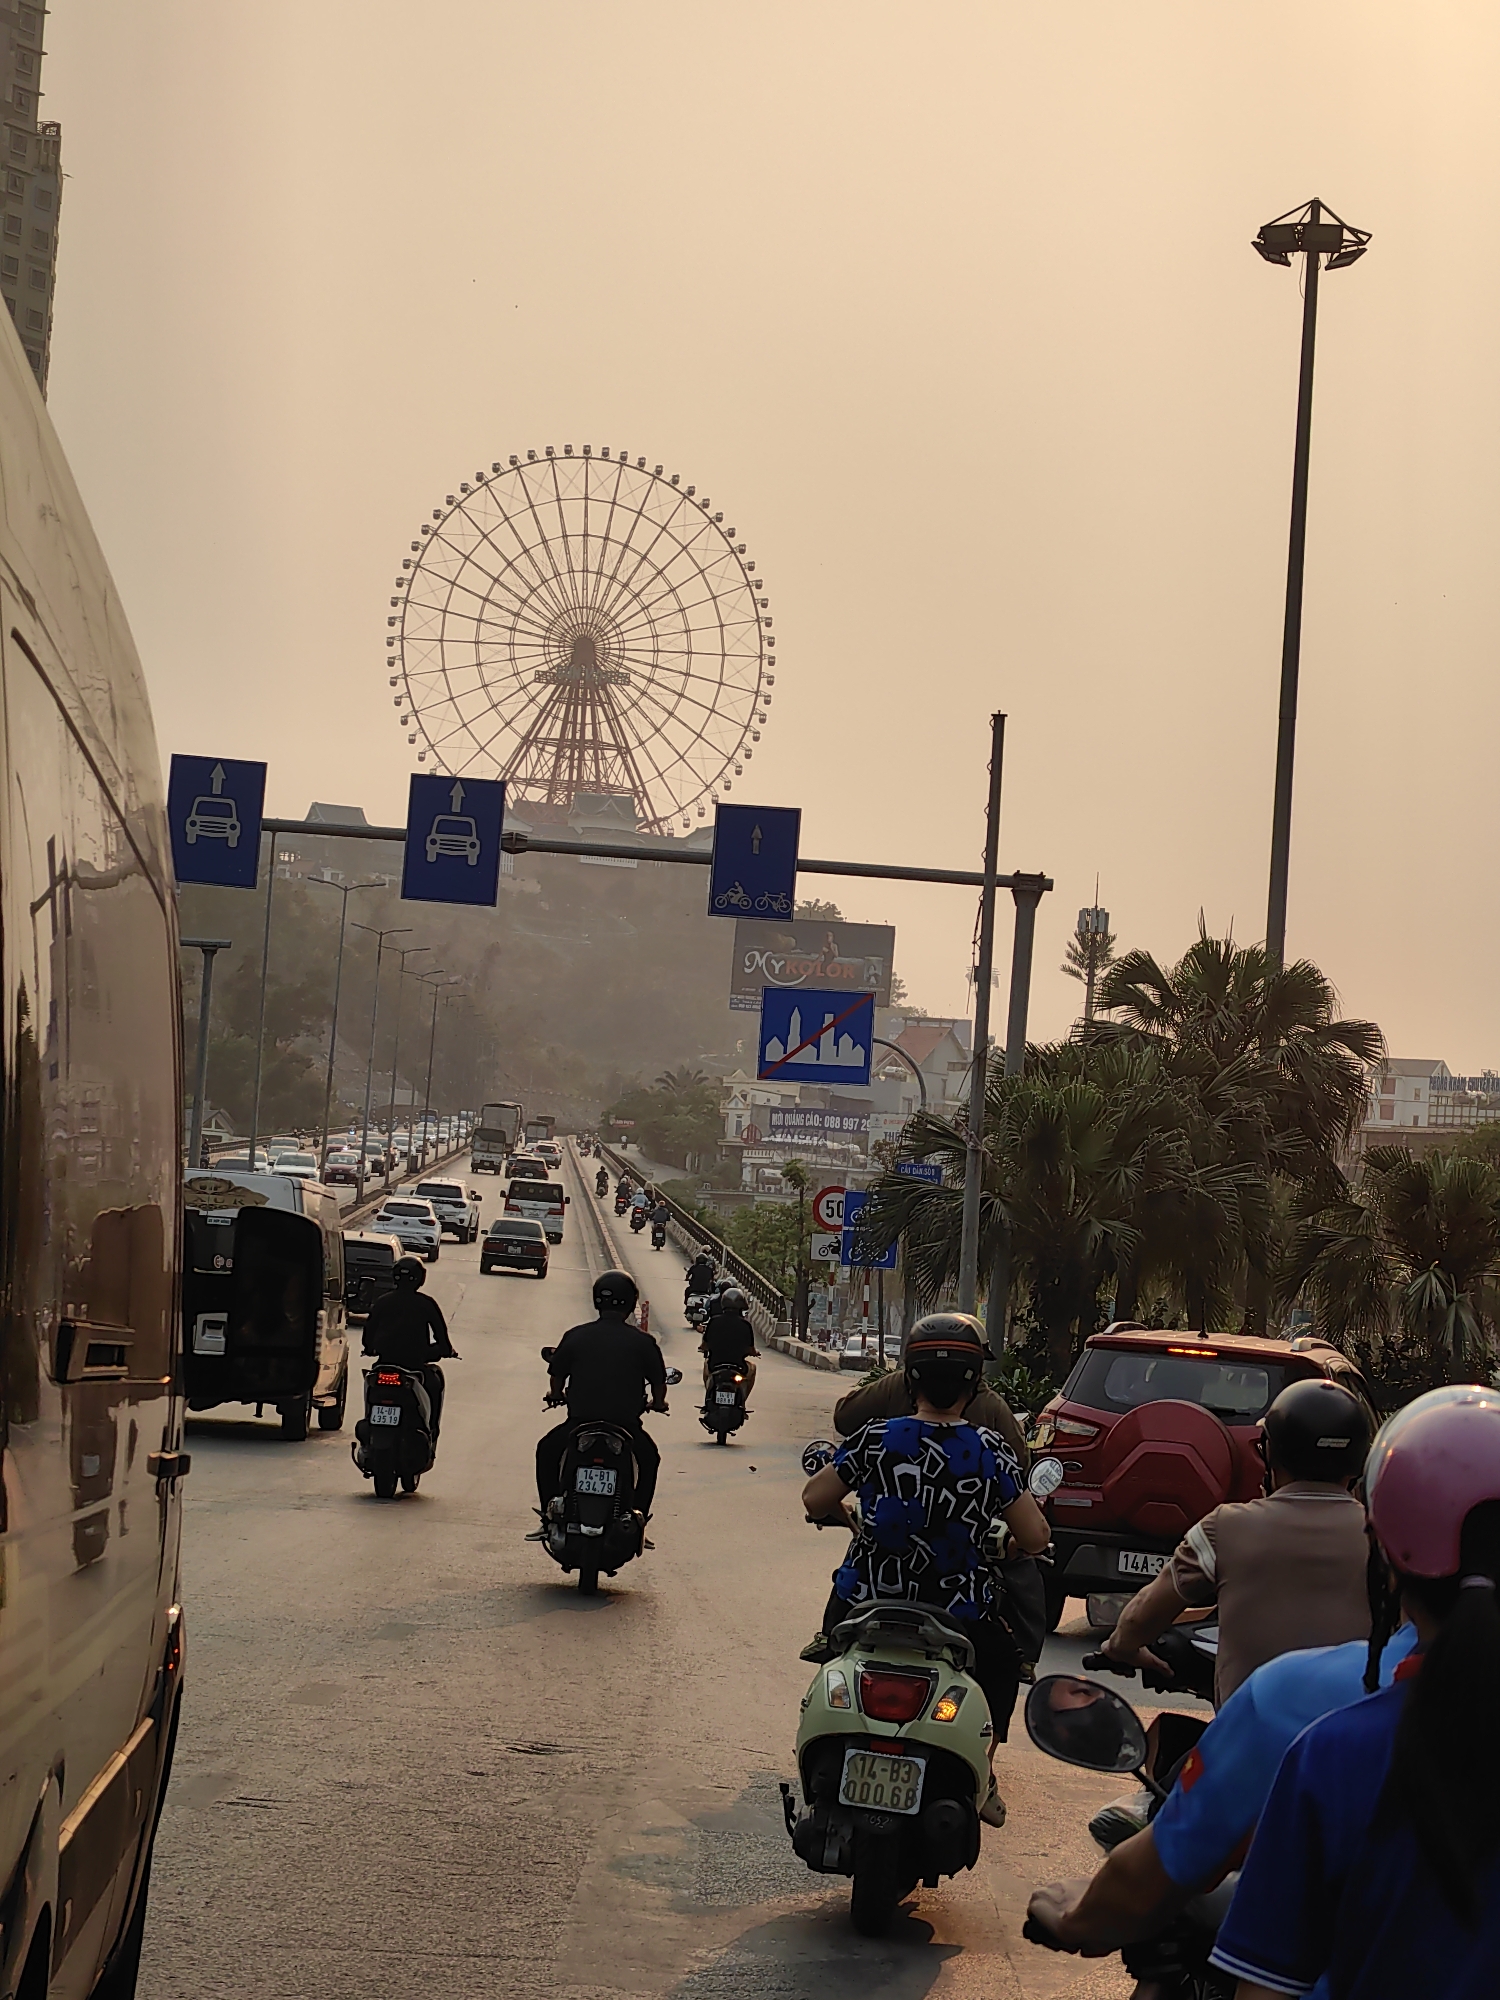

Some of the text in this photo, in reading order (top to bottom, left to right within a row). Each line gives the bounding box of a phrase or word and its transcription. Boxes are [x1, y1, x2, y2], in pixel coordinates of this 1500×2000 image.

[784, 1109, 805, 1127] QUẢNG
[805, 1110, 823, 1127] CÁO:
[824, 1115, 841, 1129] 088
[842, 1117, 859, 1131] 997
[825, 1199, 844, 1219] 50
[376, 1406, 397, 1416] 14-U1
[583, 1469, 611, 1482] 14-B1
[578, 1480, 613, 1494] 234.79
[1123, 1553, 1172, 1574] 14A-3
[859, 1756, 912, 1784] 14-B3
[847, 1779, 917, 1809] 000.68
